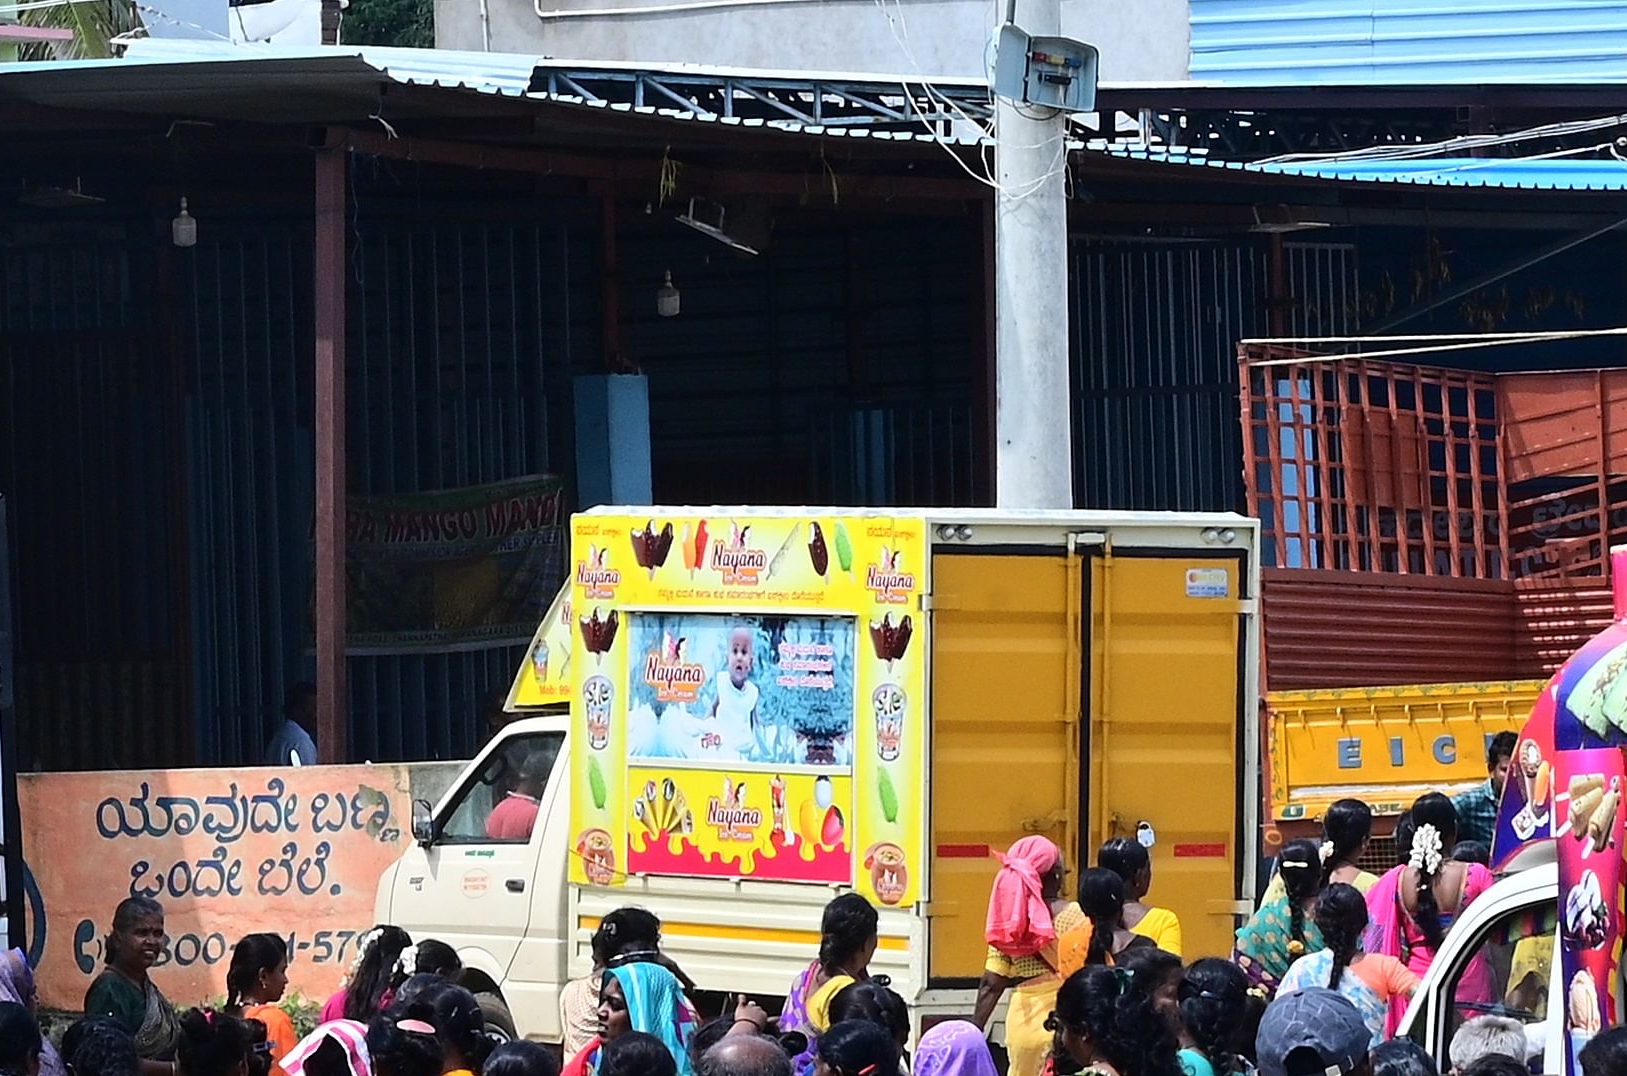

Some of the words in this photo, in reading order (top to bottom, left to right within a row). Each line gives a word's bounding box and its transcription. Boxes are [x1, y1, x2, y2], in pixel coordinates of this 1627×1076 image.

[712, 542, 765, 575] Nayana
[576, 563, 620, 589] Nayana
[867, 566, 913, 594] Nayana
[645, 655, 701, 690] Nayana
[1337, 734, 1494, 769] EIC
[95, 777, 301, 844] ಯಾವುದೇ
[707, 800, 759, 831] Nayana
[129, 846, 243, 898] ಒಂದೇ
